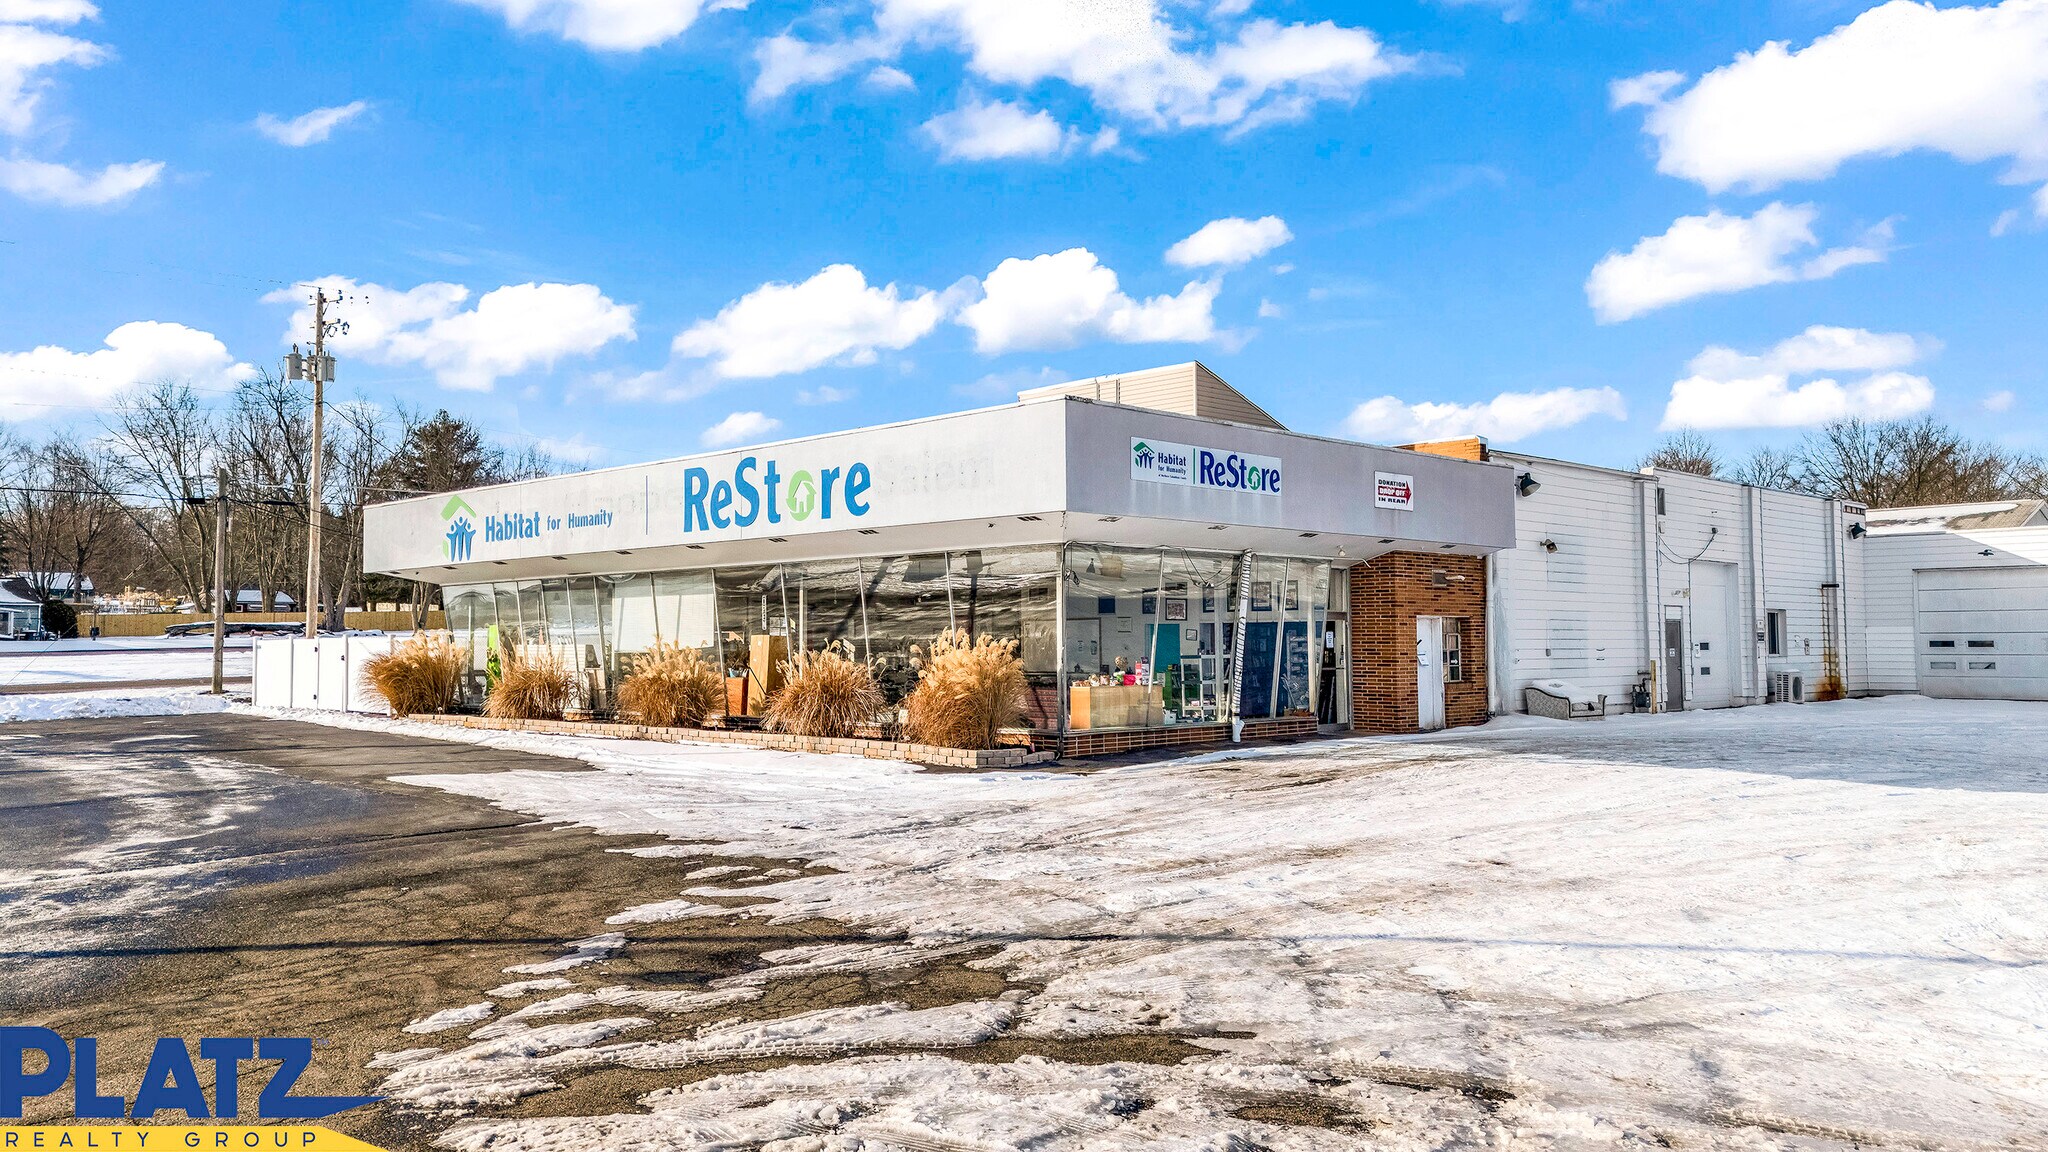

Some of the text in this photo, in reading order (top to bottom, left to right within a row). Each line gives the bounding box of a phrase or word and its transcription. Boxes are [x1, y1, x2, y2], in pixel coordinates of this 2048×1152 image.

[1158, 452, 1187, 467] Habitat
[1166, 465, 1186, 475] Humanity
[1200, 450, 1281, 493] ReStore
[1378, 479, 1406, 488] DONATION
[684, 456, 871, 533] ReStore
[1379, 487, 1405, 497] DROP OFF
[485, 508, 613, 543] Habitat for Humanity
